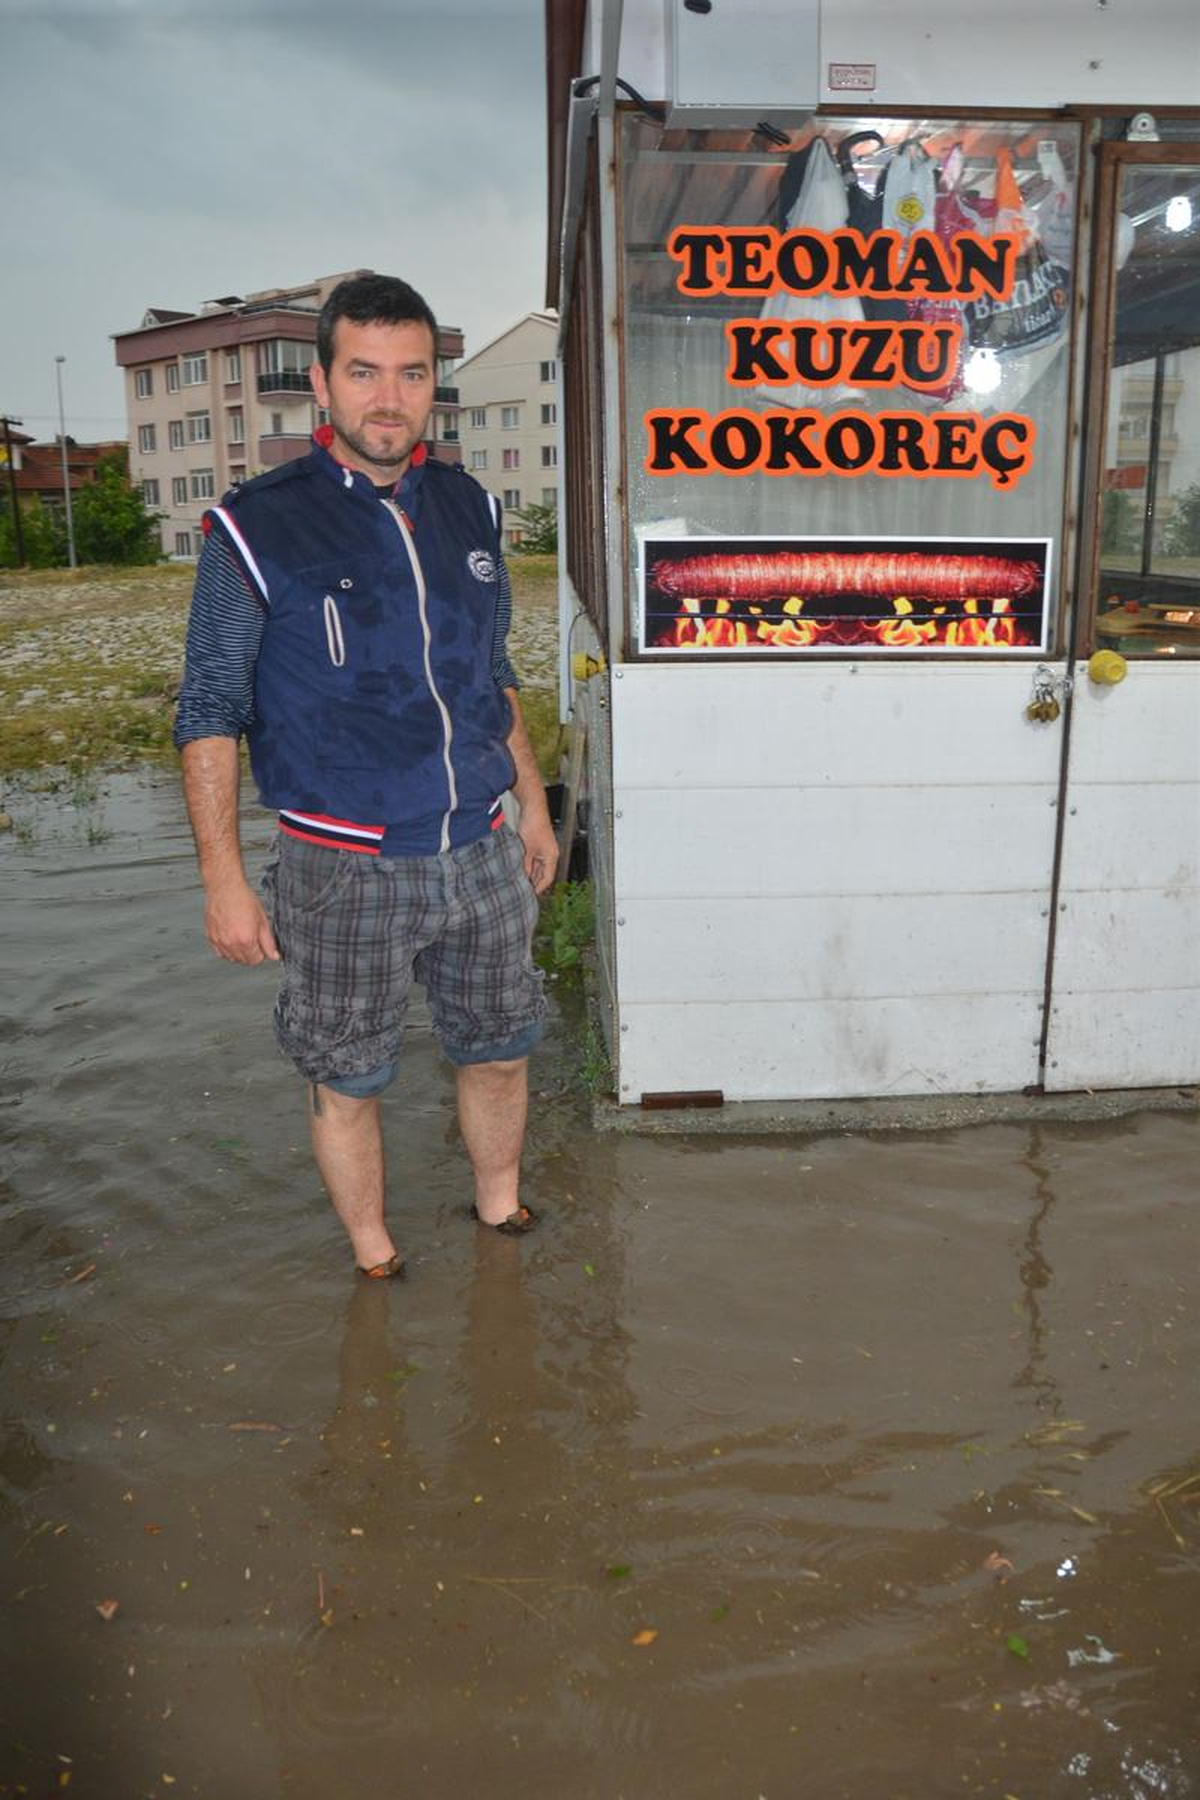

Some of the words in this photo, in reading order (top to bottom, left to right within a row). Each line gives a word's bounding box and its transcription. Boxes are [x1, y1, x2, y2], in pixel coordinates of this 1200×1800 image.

[672, 232, 1014, 295] TEOMAN
[730, 324, 957, 384] KUZU
[648, 414, 1031, 487] KOKOREÇ
